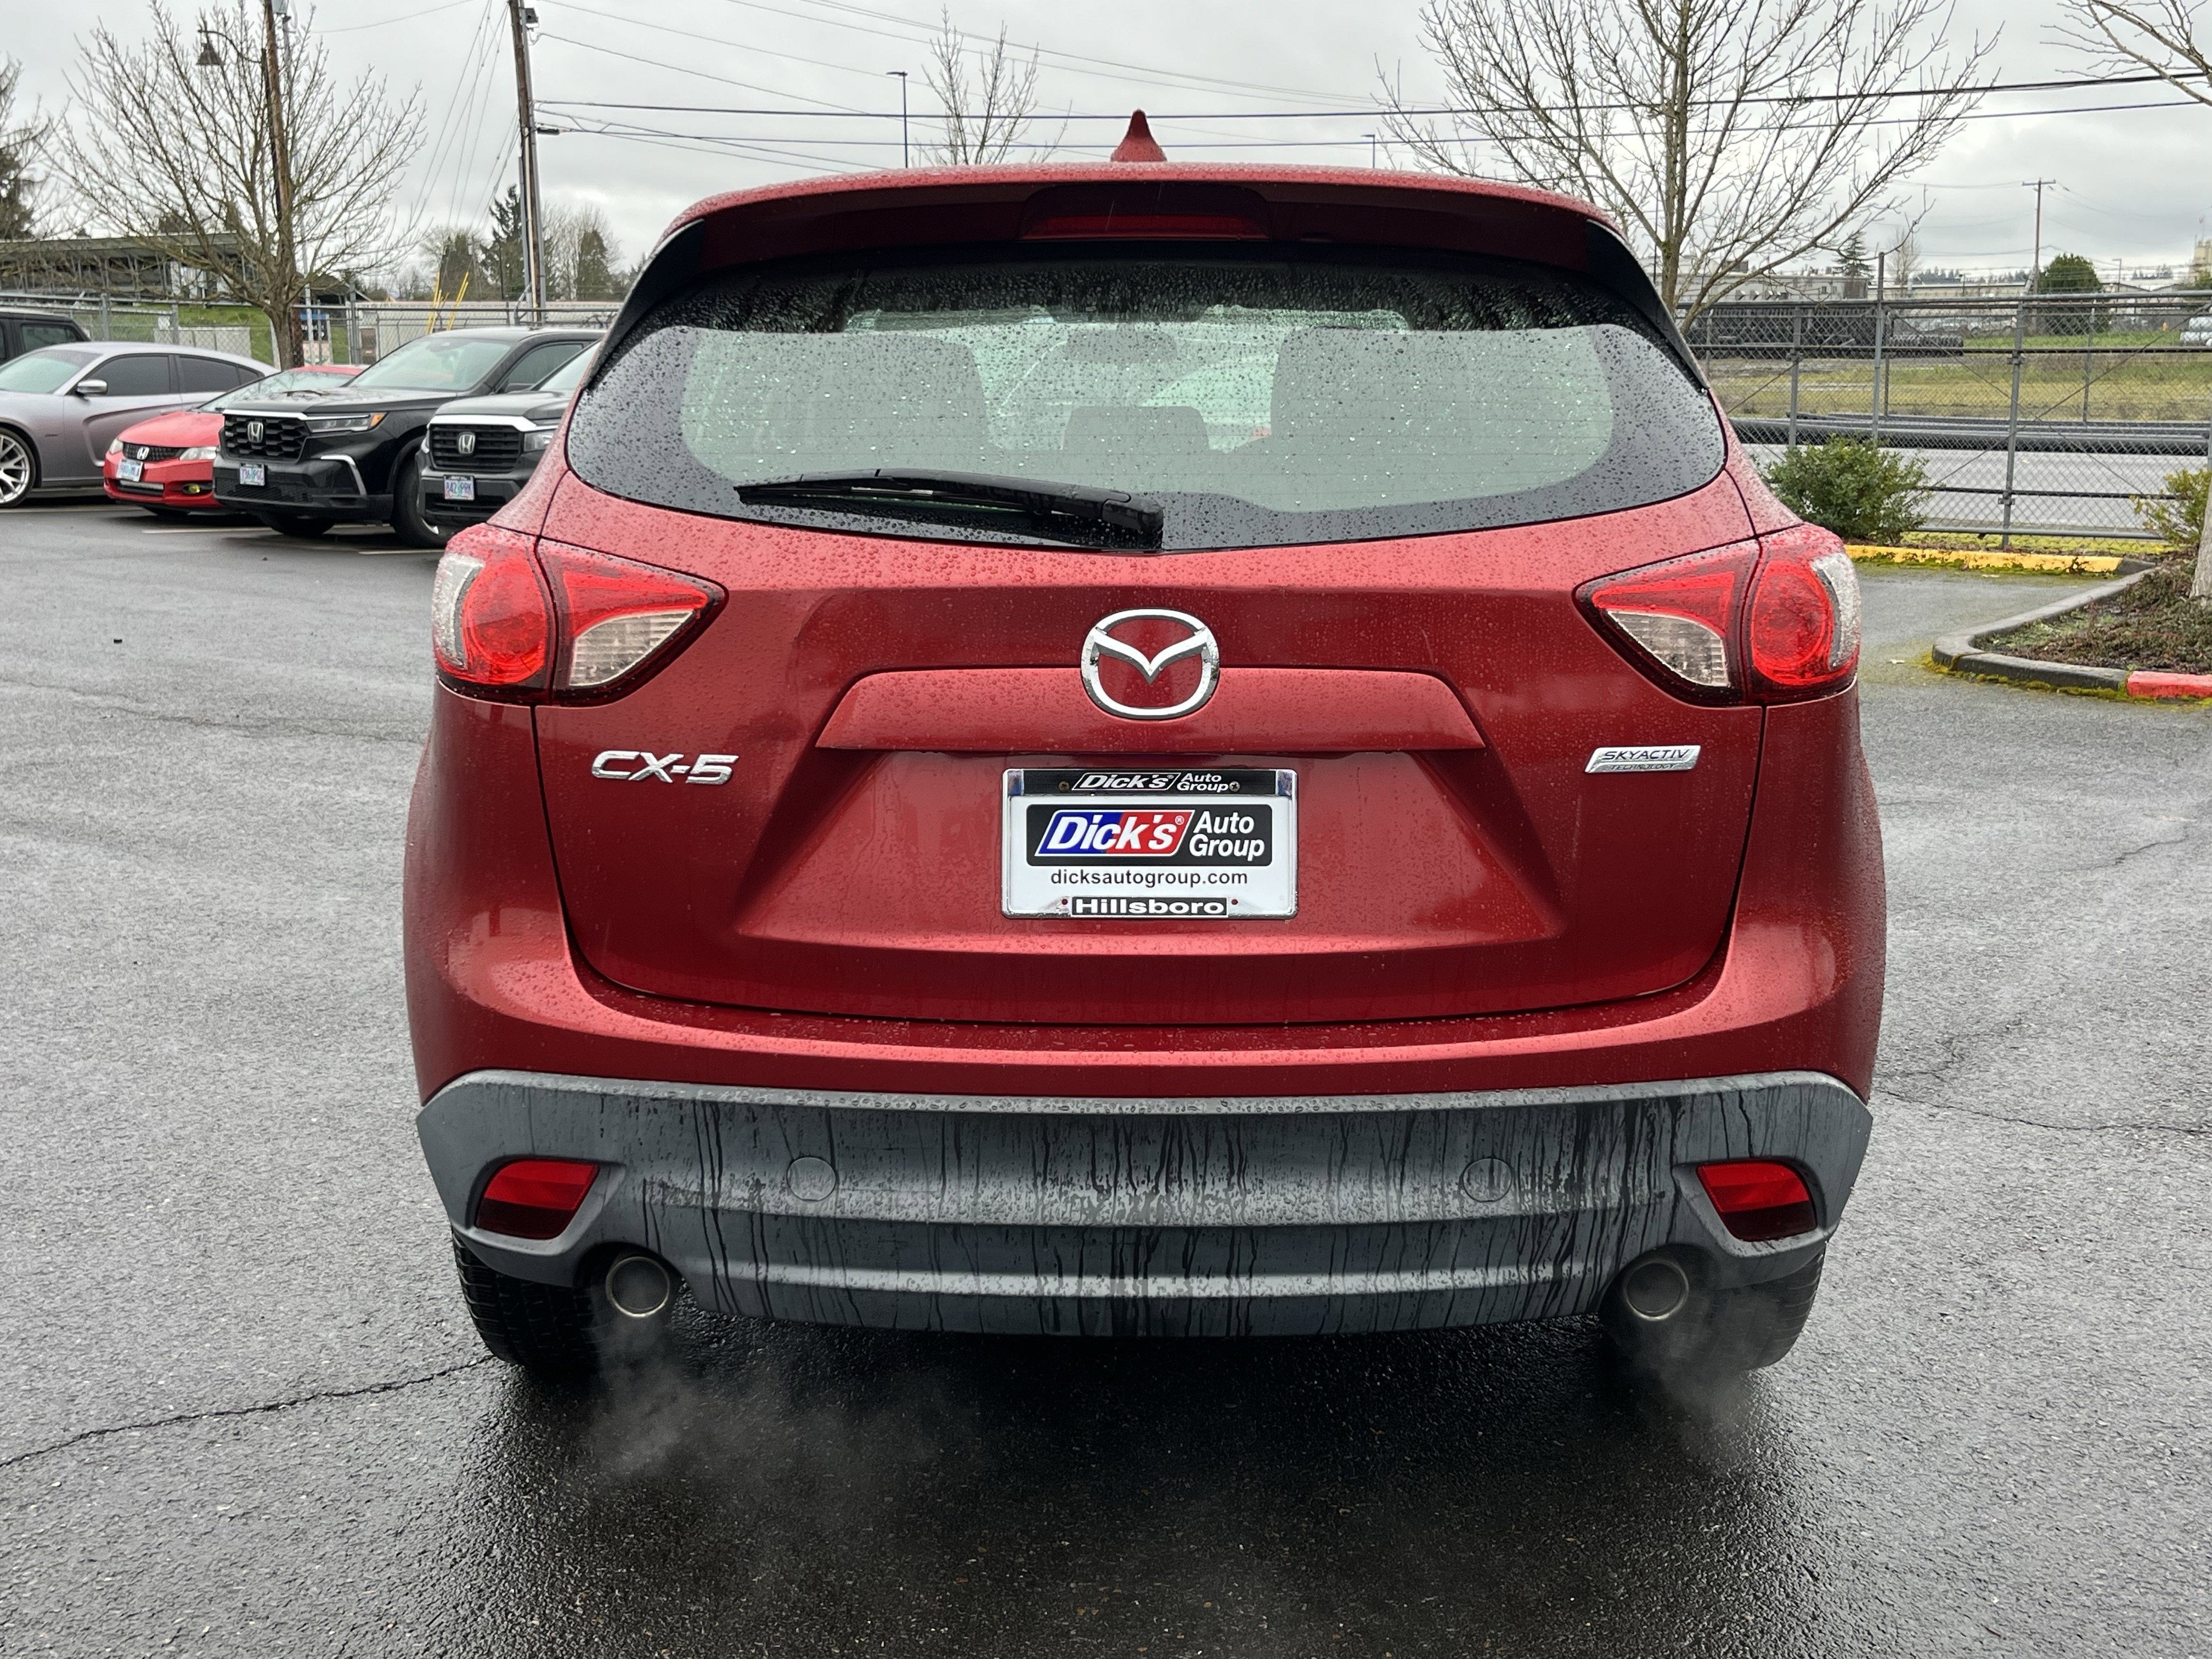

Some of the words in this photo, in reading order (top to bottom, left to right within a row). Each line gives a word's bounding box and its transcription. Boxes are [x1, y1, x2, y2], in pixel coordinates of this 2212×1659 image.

[1602, 749, 1690, 761] SKYACTIV
[591, 750, 740, 785] CX-5
[1610, 763, 1675, 771] TECHNOLOGY
[1079, 774, 1169, 788] Dick's
[1181, 772, 1222, 782] Auto
[1177, 781, 1229, 793] Group
[1193, 811, 1255, 834] Auto
[1046, 814, 1177, 850] Dick's
[1189, 834, 1265, 861] Group
[1051, 869, 1248, 888] dicksautogroup.com
[1075, 898, 1224, 914] Hillsboro
